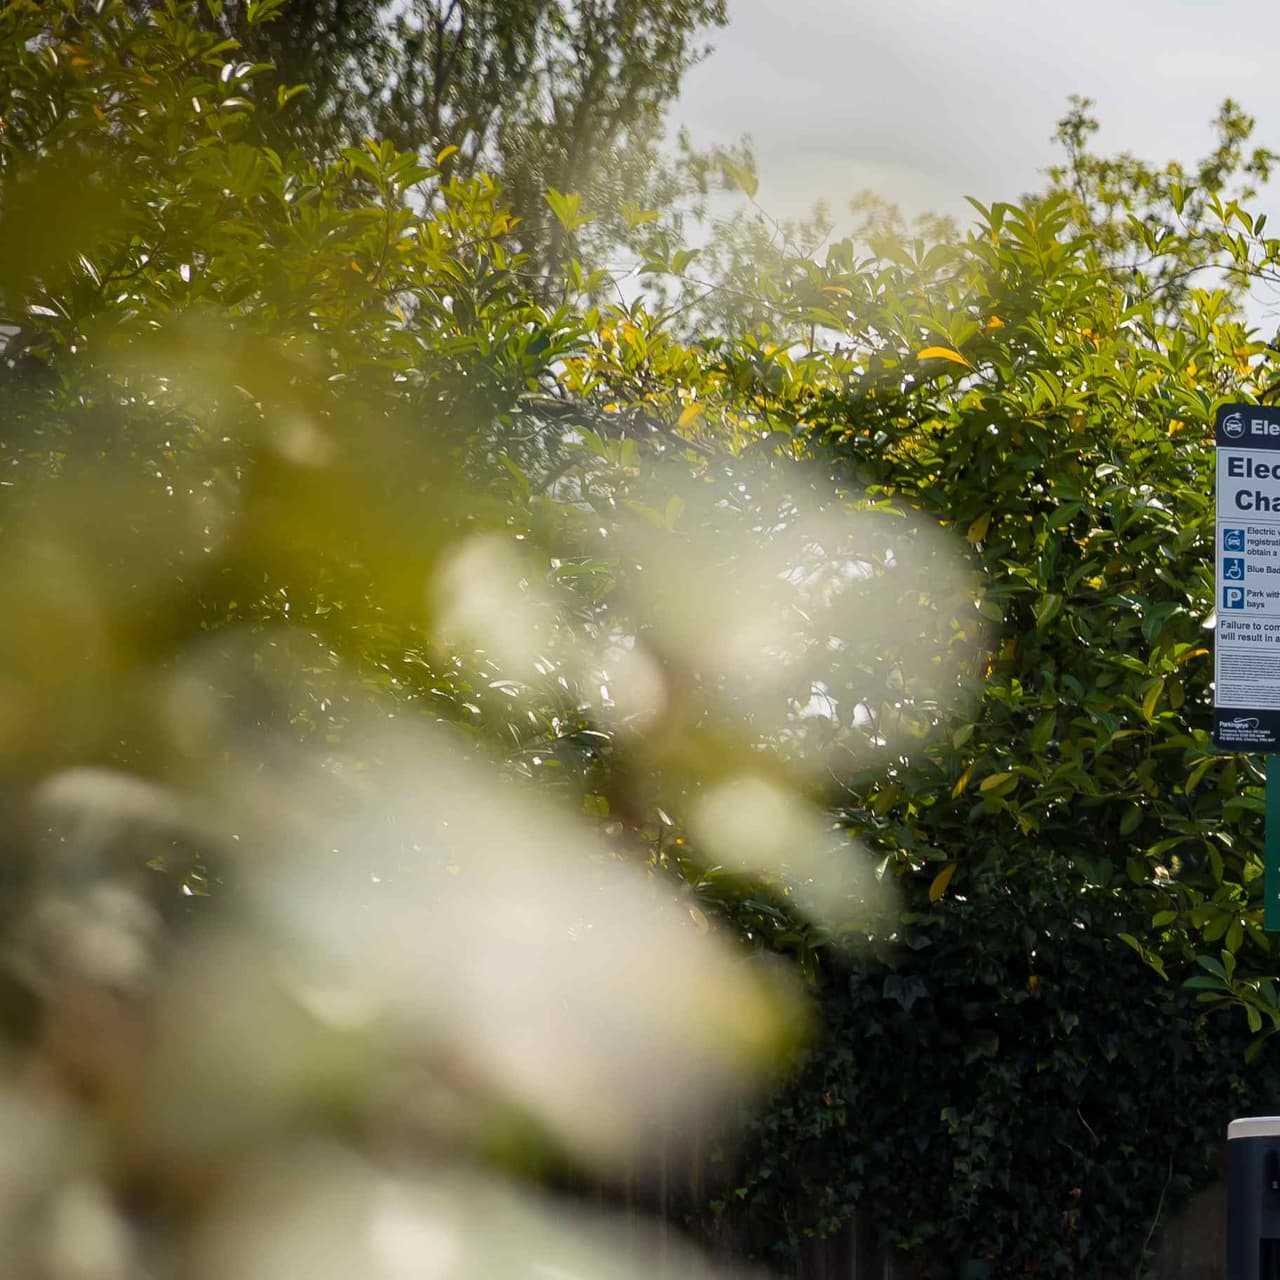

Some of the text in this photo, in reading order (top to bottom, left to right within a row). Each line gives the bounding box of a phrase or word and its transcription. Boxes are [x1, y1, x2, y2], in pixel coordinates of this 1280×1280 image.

[1247, 527, 1276, 536] Electric
[1247, 565, 1264, 573] Blue
[1227, 589, 1242, 607] P
[1247, 601, 1265, 609] bays
[1221, 621, 1250, 630] Failure
[1221, 632, 1235, 640] will
[1238, 634, 1262, 642] result
[1265, 634, 1273, 642] in
